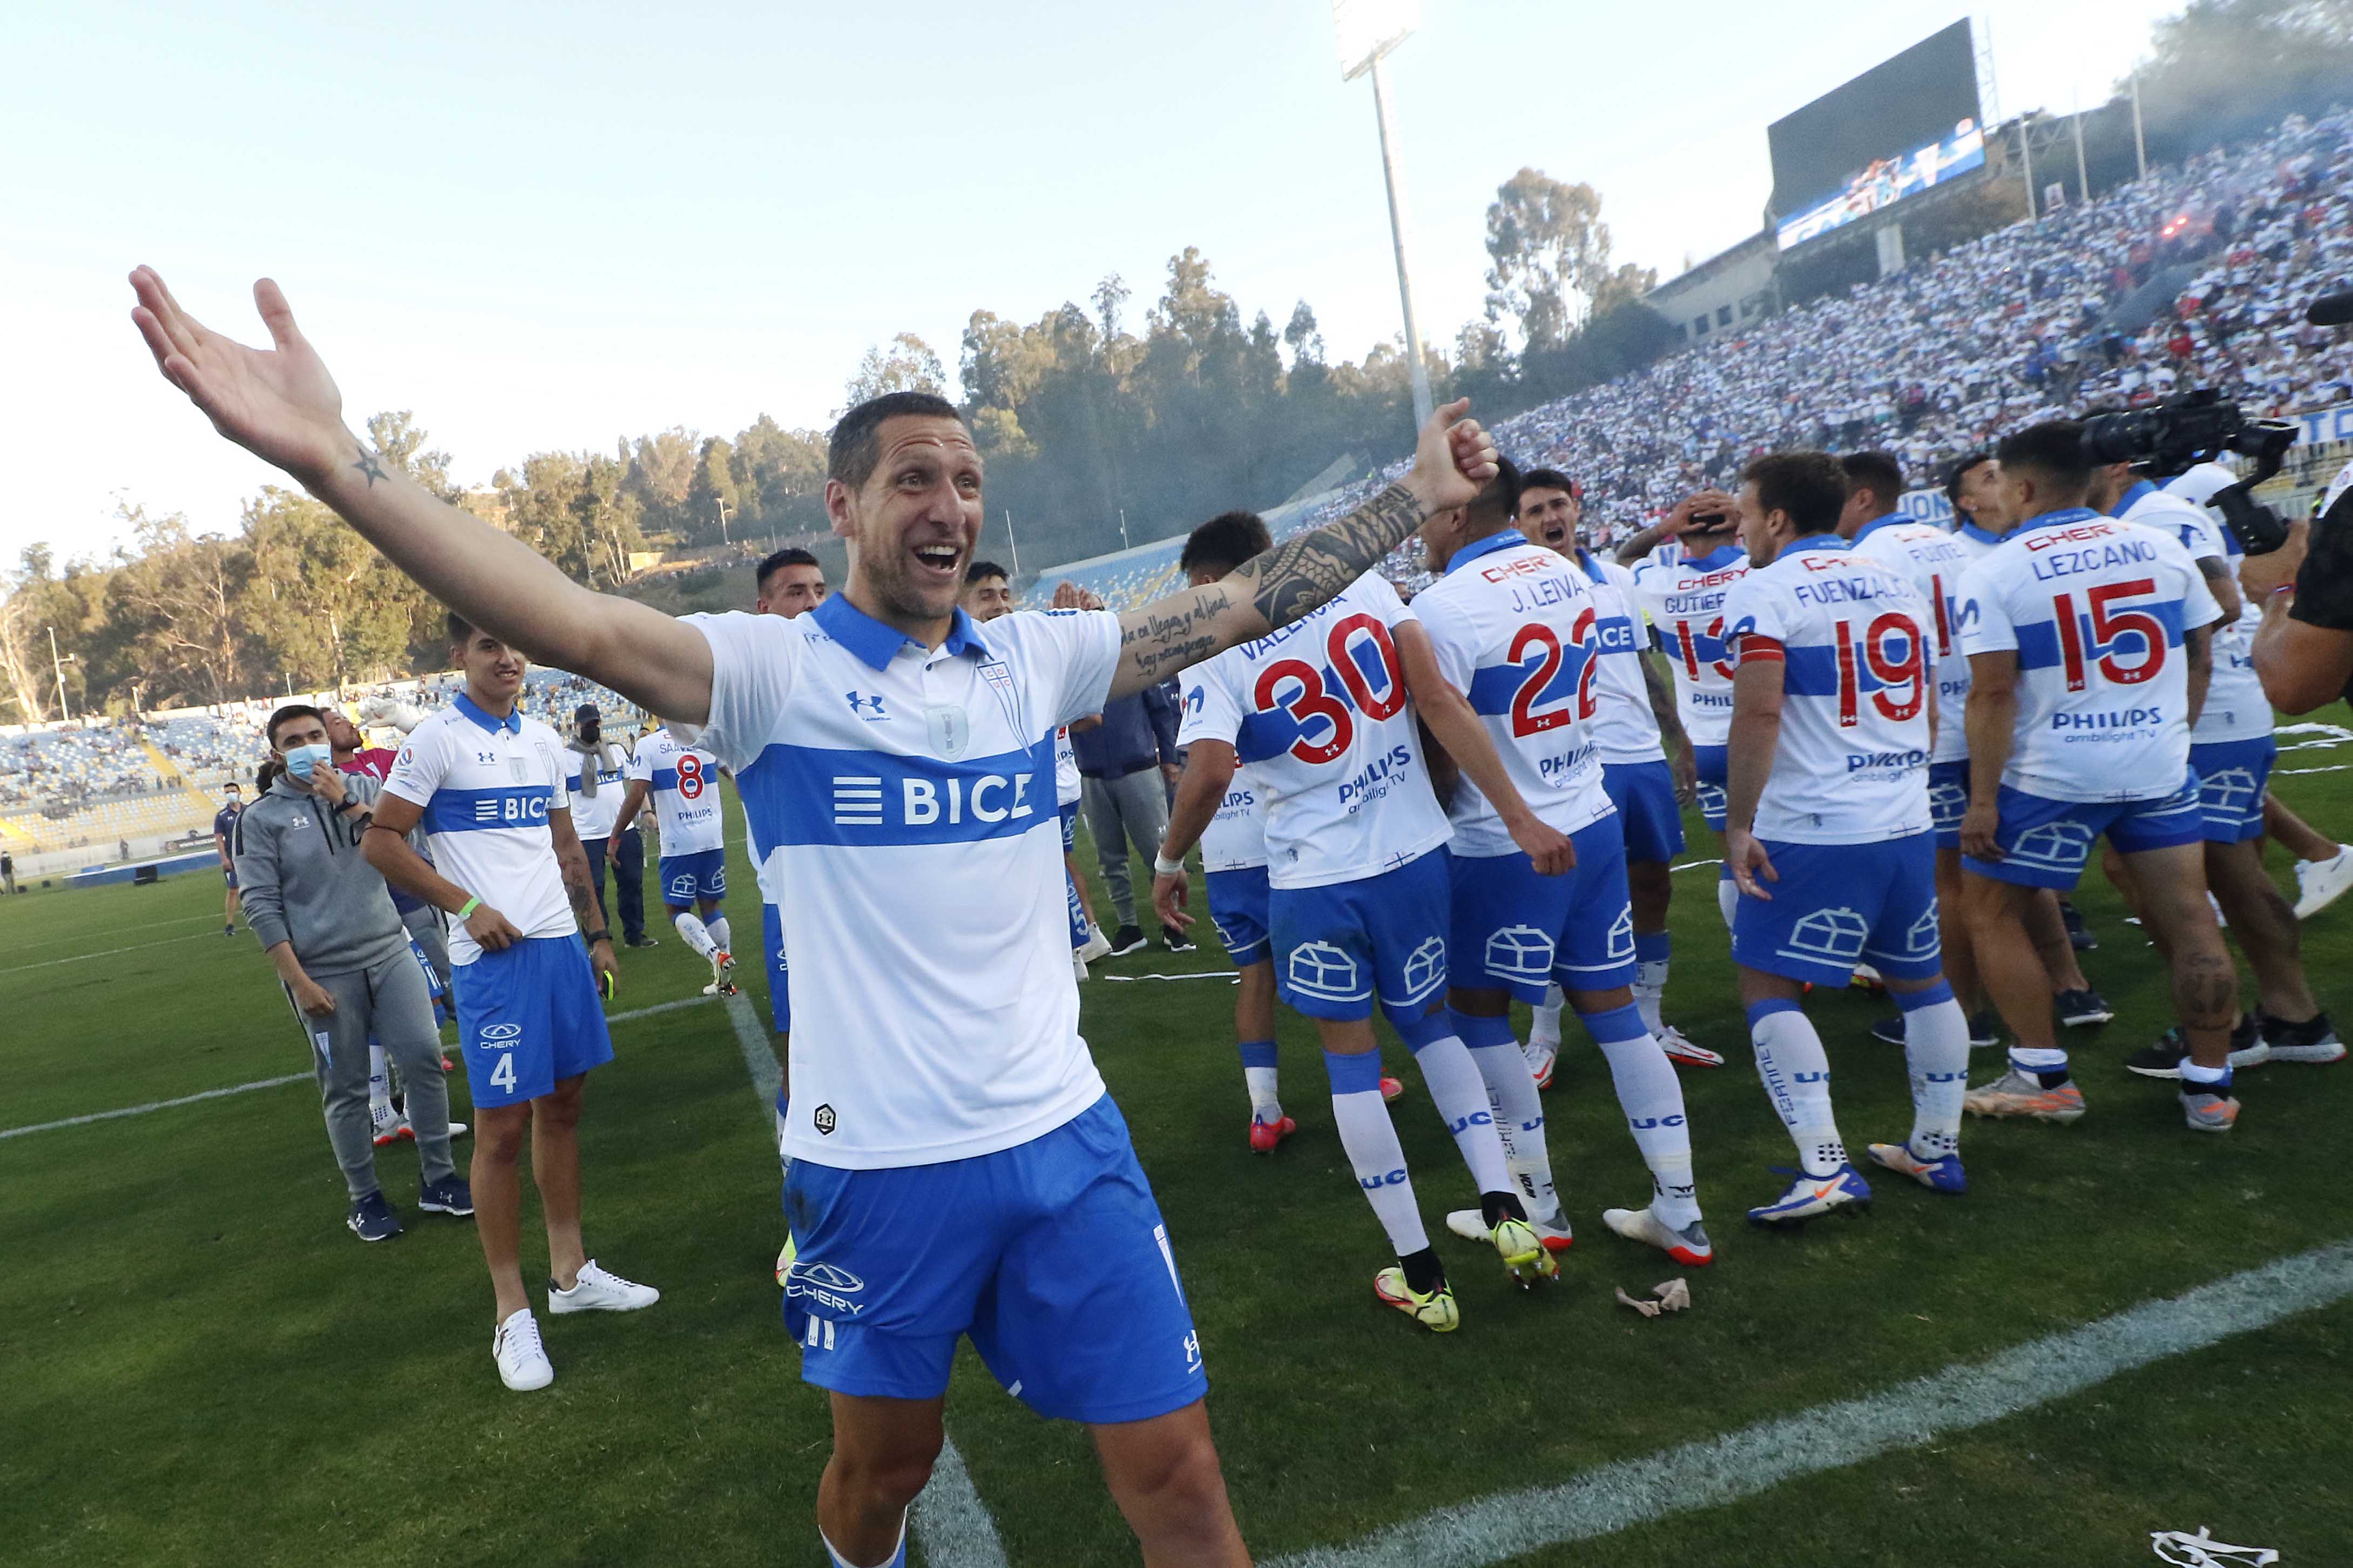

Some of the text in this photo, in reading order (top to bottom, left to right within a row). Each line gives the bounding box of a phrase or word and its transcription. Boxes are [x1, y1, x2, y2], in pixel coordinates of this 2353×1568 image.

[2025, 524, 2129, 552] CHER
[1678, 567, 1750, 589] CHERY
[2032, 541, 2156, 581] LEZCANO
[1512, 574, 1585, 613] J. LEIVA
[2054, 579, 2166, 692] 15
[1254, 613, 1405, 764] 30
[1836, 612, 1923, 728] 19
[2052, 707, 2162, 729] PHILIPS
[677, 755, 704, 800] 8
[1389, 770, 1405, 785] TV
[678, 809, 713, 820] PHILIPS
[902, 773, 1033, 825] BICE
[480, 1039, 520, 1049] CHERY
[490, 1052, 517, 1094] 4
[786, 1285, 864, 1315] CHERY
